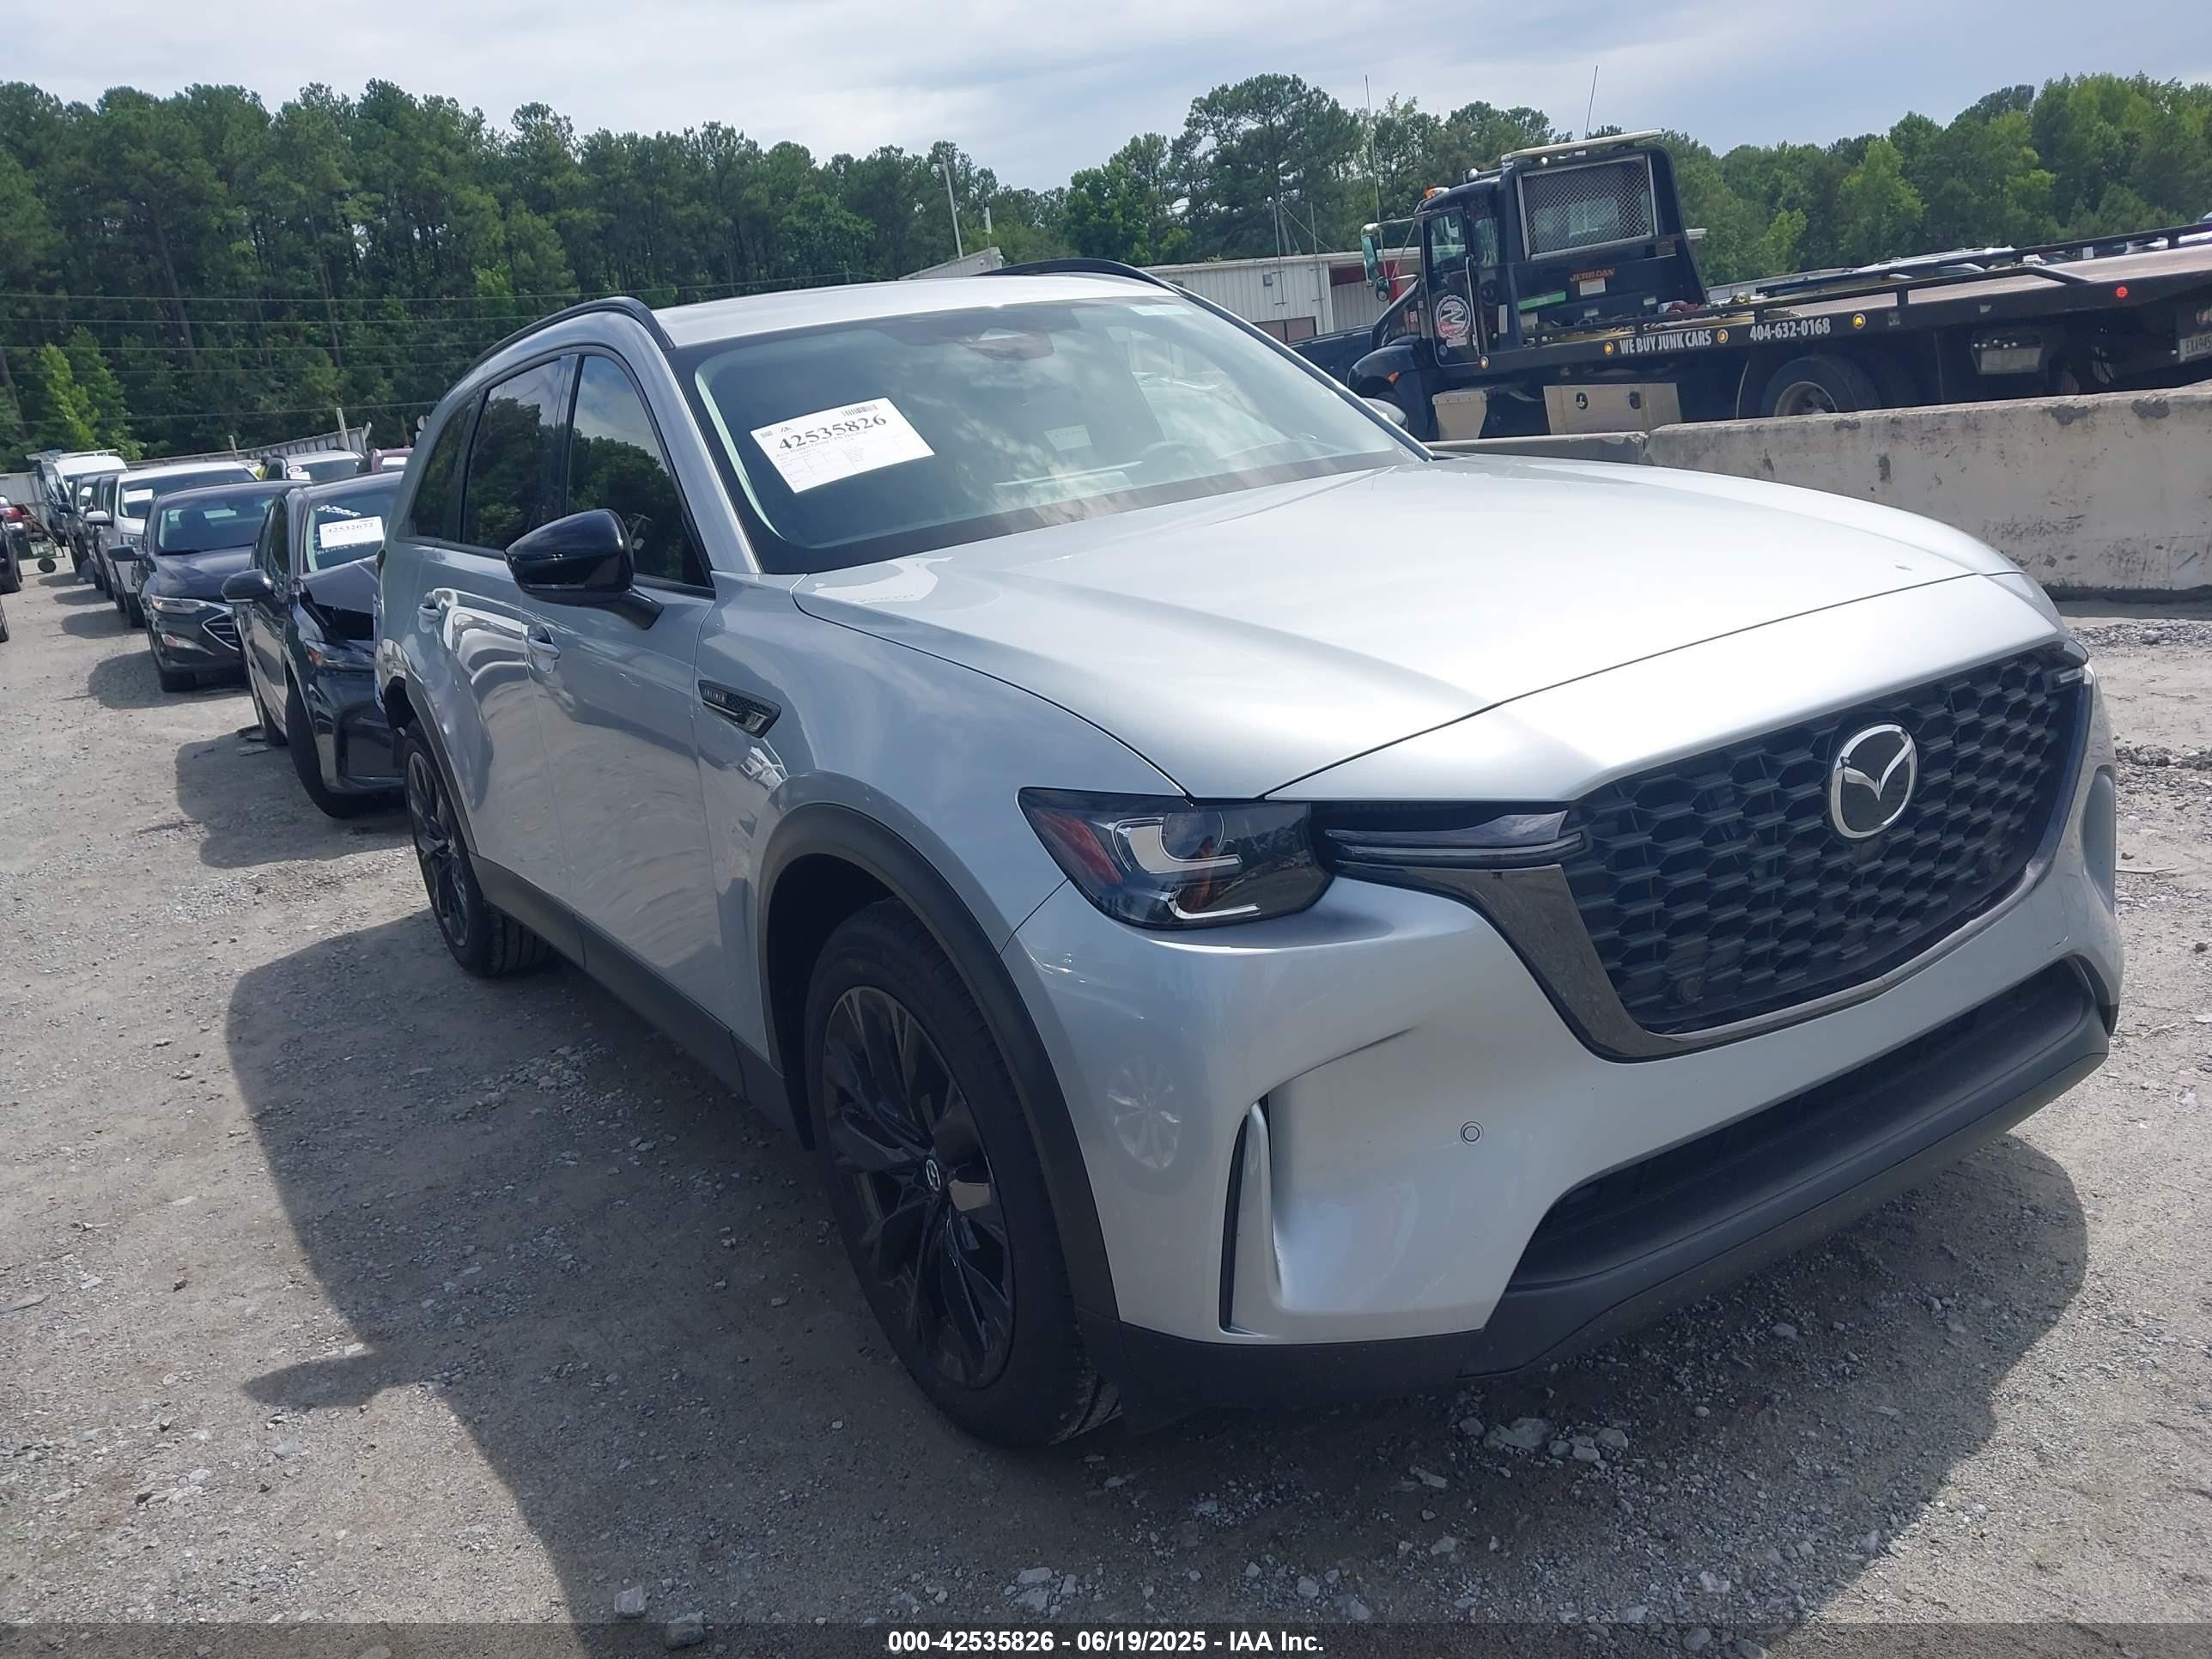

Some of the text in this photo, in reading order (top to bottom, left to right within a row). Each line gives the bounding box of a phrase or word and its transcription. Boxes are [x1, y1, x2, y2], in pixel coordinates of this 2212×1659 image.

[1619, 329, 1712, 355] WE BUY JUNK CARS
[1748, 317, 1832, 342] 404-632-0168
[778, 413, 888, 451] 42535826
